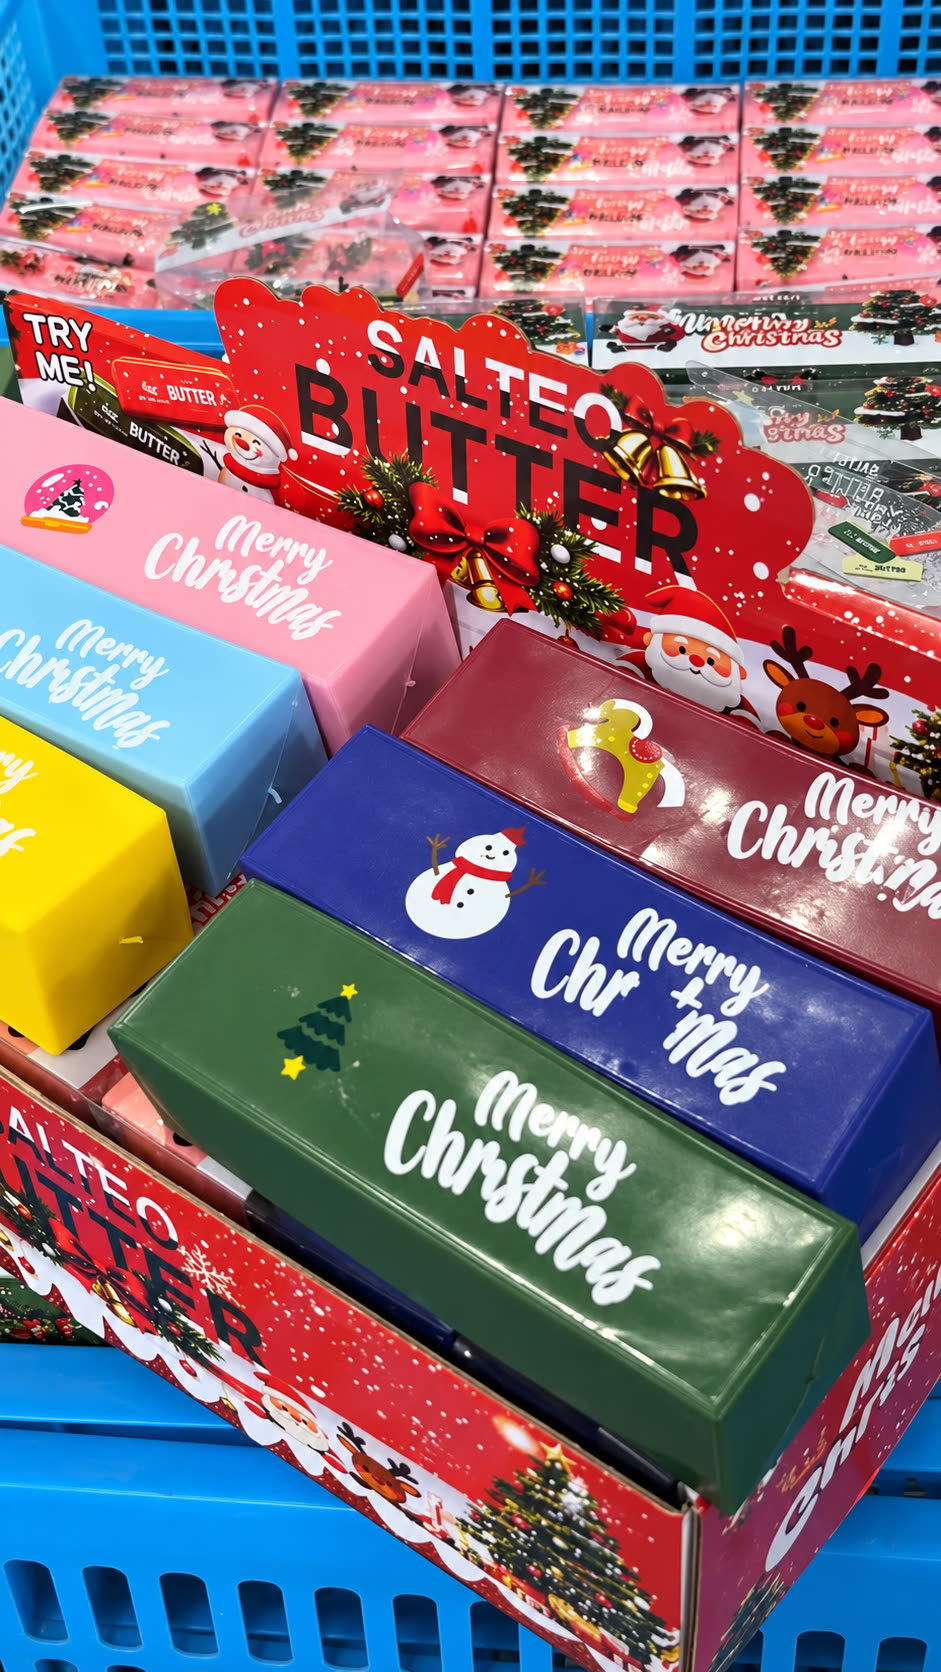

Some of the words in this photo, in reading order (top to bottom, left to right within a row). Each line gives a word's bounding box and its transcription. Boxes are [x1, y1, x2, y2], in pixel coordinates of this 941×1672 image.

[22, 312, 93, 353] TRY
[34, 350, 96, 392] ME!
[166, 384, 217, 407] BUTTER
[129, 421, 181, 466] BUTTER
[295, 363, 698, 592] BUTTER
[214, 515, 333, 586] Merry
[55, 618, 170, 690] Merry
[804, 771, 941, 857] Merry
[616, 907, 770, 1017] Merry
[473, 1070, 638, 1201] Merry
